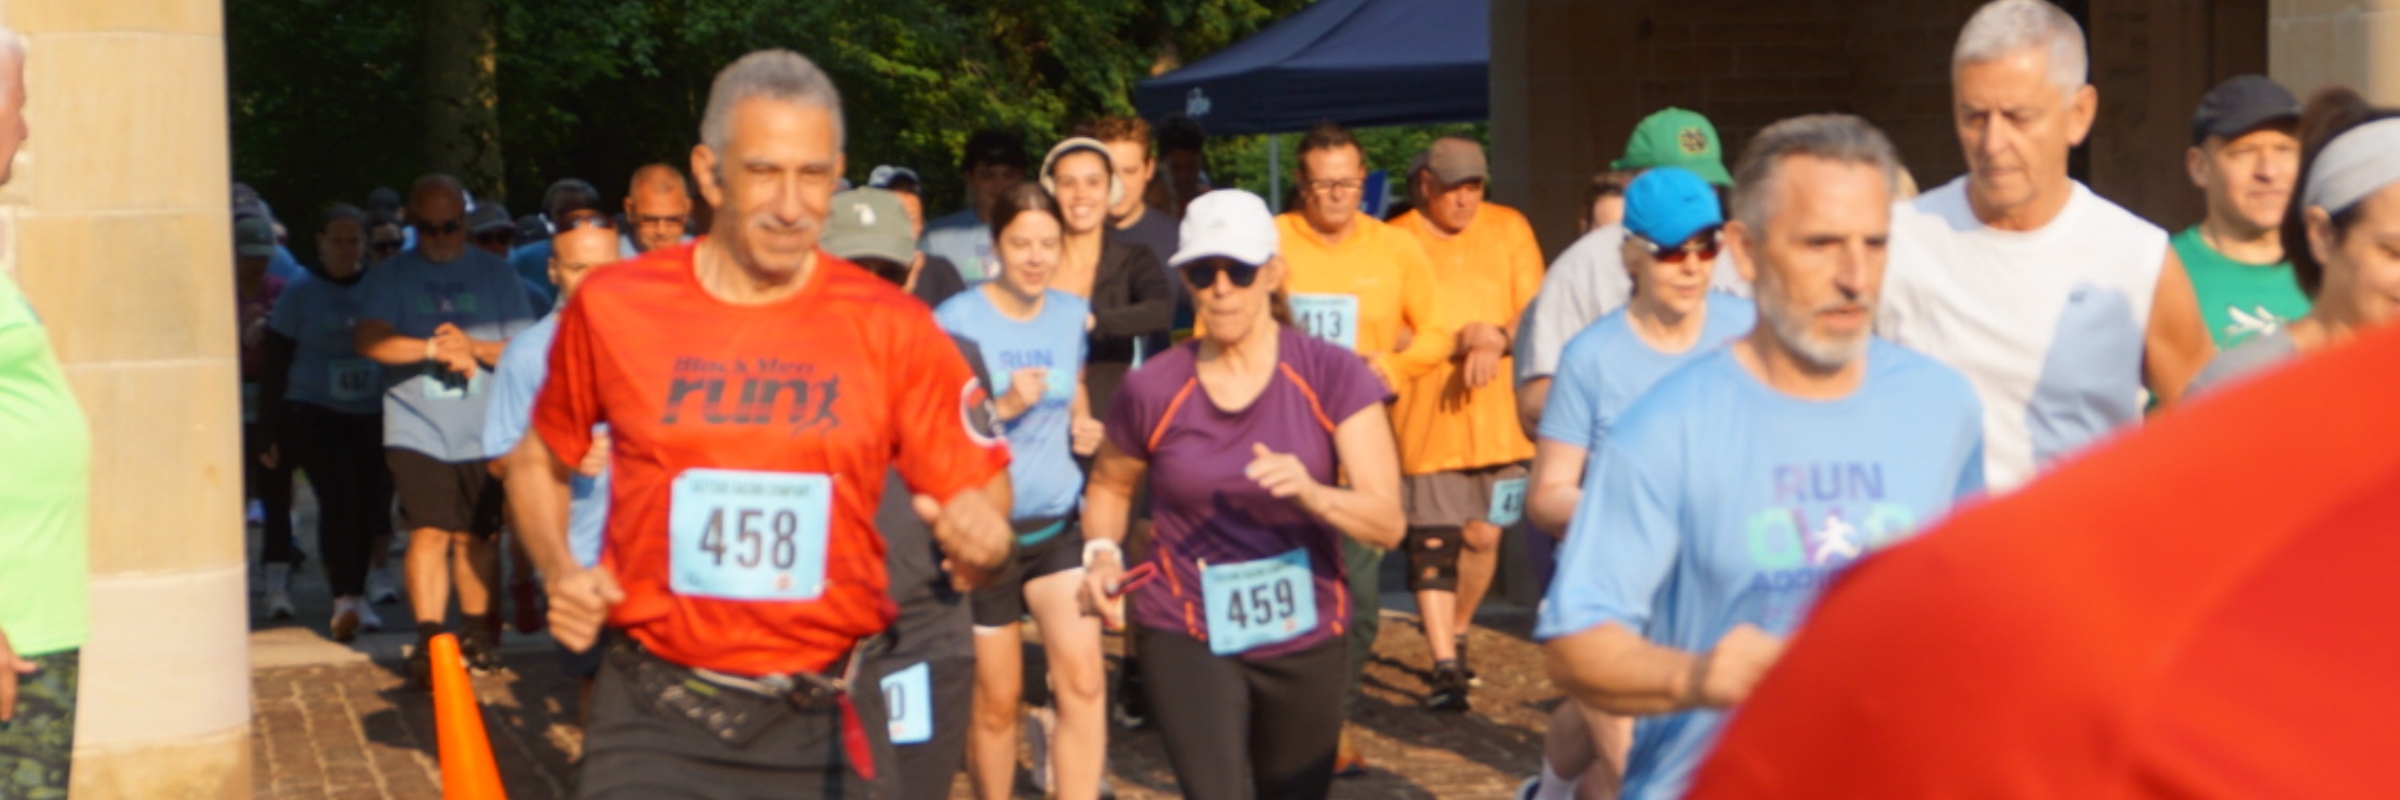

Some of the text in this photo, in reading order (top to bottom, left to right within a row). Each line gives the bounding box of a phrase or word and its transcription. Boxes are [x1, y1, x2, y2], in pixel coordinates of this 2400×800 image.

[1300, 309, 1342, 337] 413
[662, 379, 808, 424] run
[1772, 462, 1884, 501] RUN
[700, 508, 797, 568] 458
[1228, 578, 1294, 628] 459
